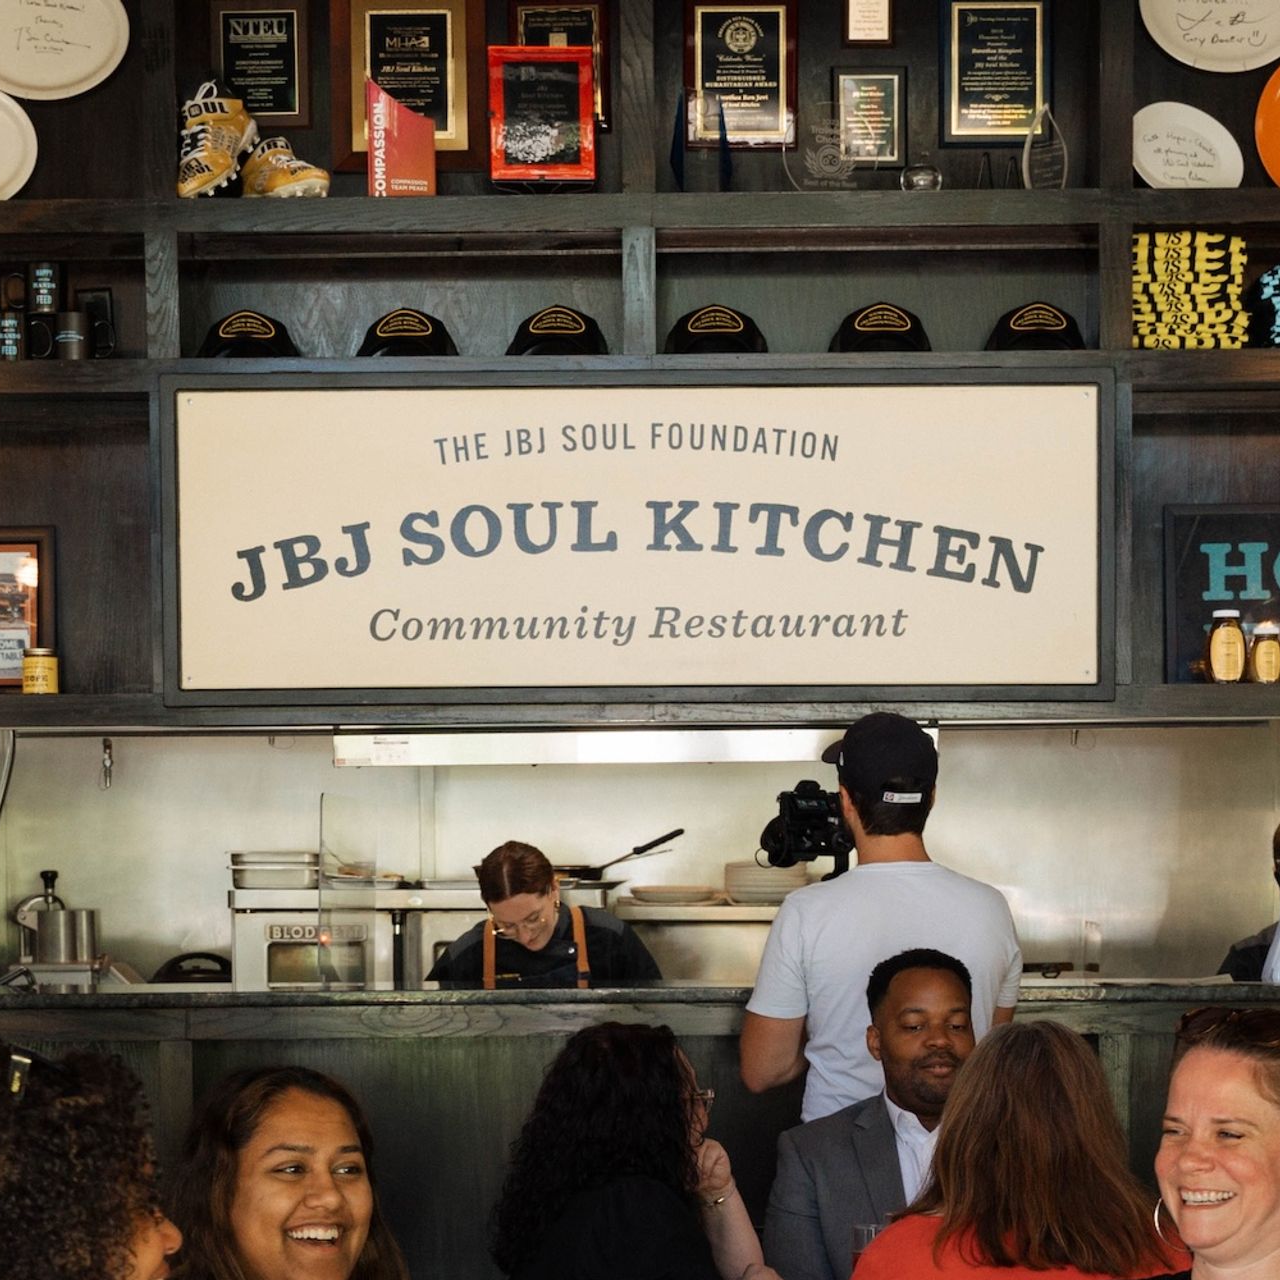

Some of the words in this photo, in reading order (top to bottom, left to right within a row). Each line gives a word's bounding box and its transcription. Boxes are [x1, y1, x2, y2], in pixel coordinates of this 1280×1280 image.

[228, 17, 288, 36] NTEU
[433, 433, 489, 466] THE
[504, 428, 545, 457] JBJ
[561, 424, 636, 452] SOUL
[651, 422, 839, 463] FOUNDATION
[230, 521, 373, 603] JBJ
[399, 500, 618, 567] SOUL
[645, 500, 1045, 594] KITCHEN
[369, 608, 637, 647] Community
[648, 606, 909, 640] Restaurant
